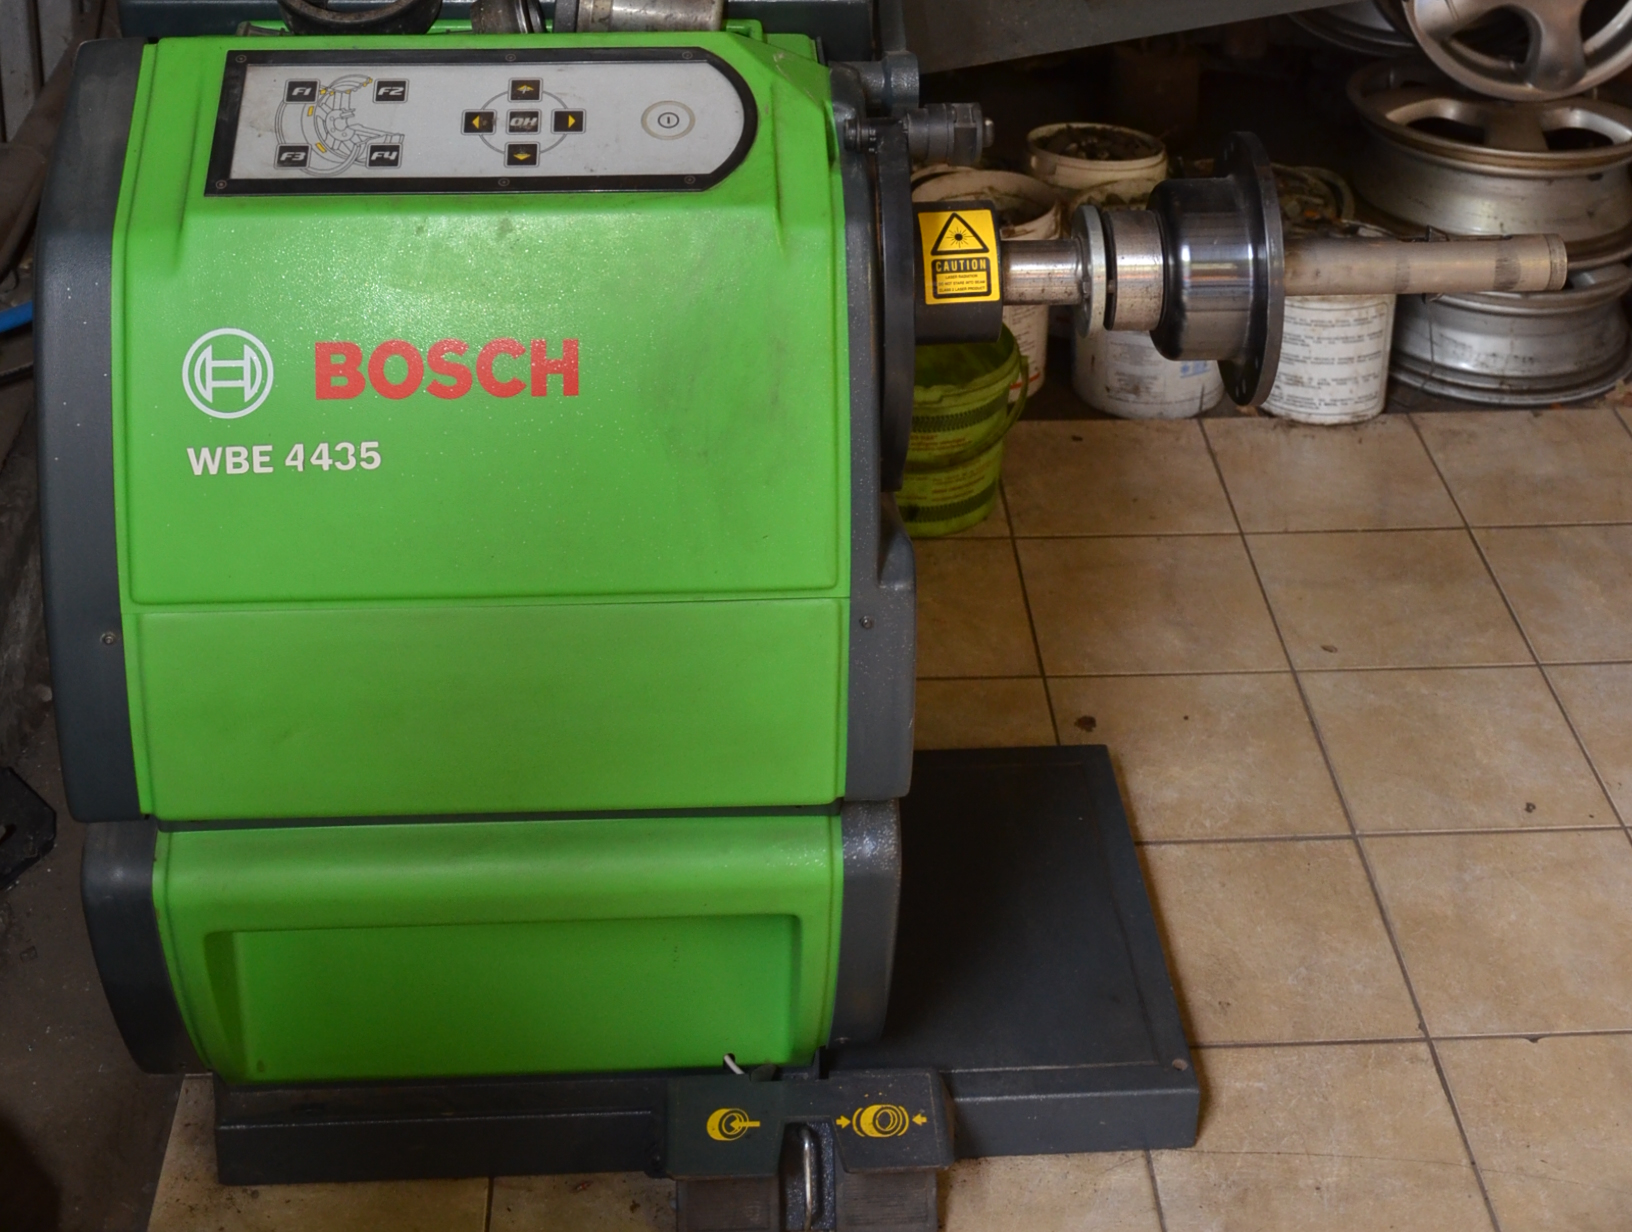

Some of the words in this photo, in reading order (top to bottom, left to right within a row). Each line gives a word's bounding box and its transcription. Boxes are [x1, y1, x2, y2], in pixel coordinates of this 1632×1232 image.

[291, 87, 312, 96] F1
[378, 86, 404, 96] F2
[280, 151, 306, 161] F3
[371, 150, 398, 161] F4
[936, 259, 986, 272] CAUTION
[315, 337, 579, 400] BOSCH
[187, 445, 274, 476] WBE
[285, 441, 381, 473] 4435
